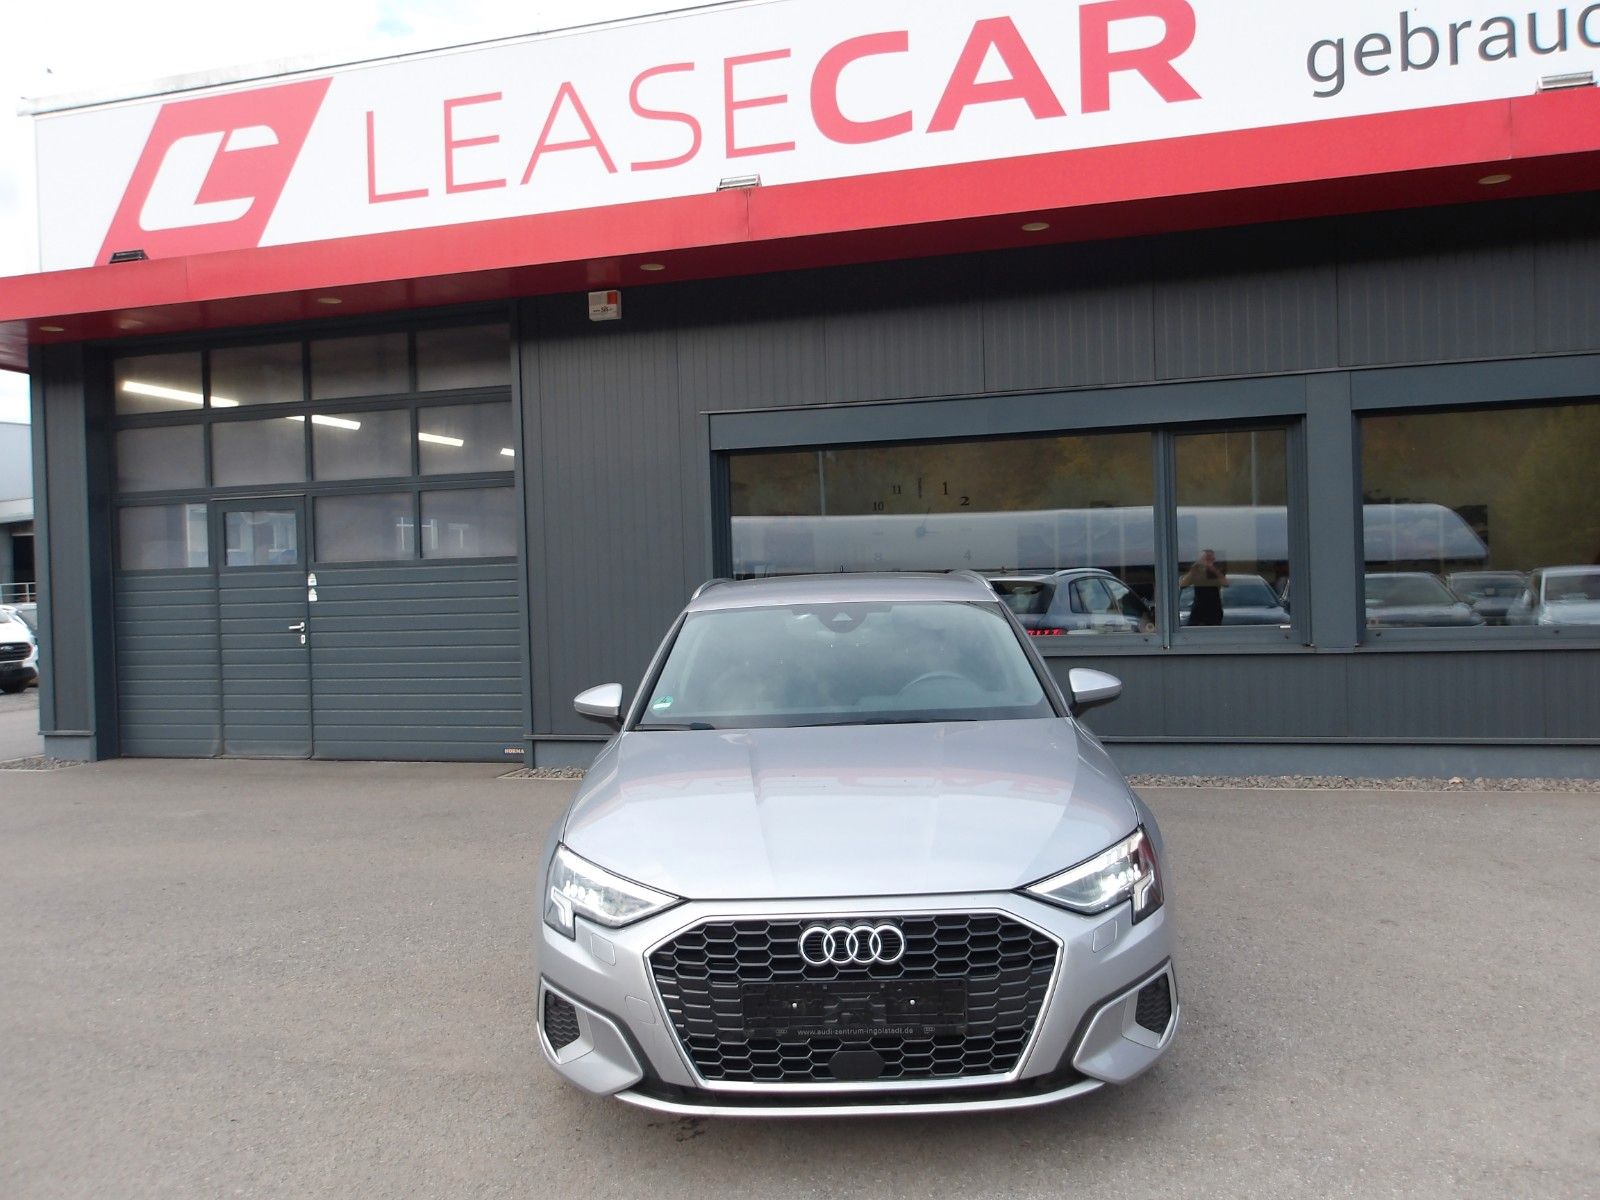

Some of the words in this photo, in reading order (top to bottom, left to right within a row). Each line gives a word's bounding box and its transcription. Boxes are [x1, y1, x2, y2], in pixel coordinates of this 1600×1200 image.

[367, 0, 1202, 204] LEASECAR
[960, 496, 970, 506] 2
[797, 1026, 913, 1036] www.audi-zentrum-ingolstadt.de
